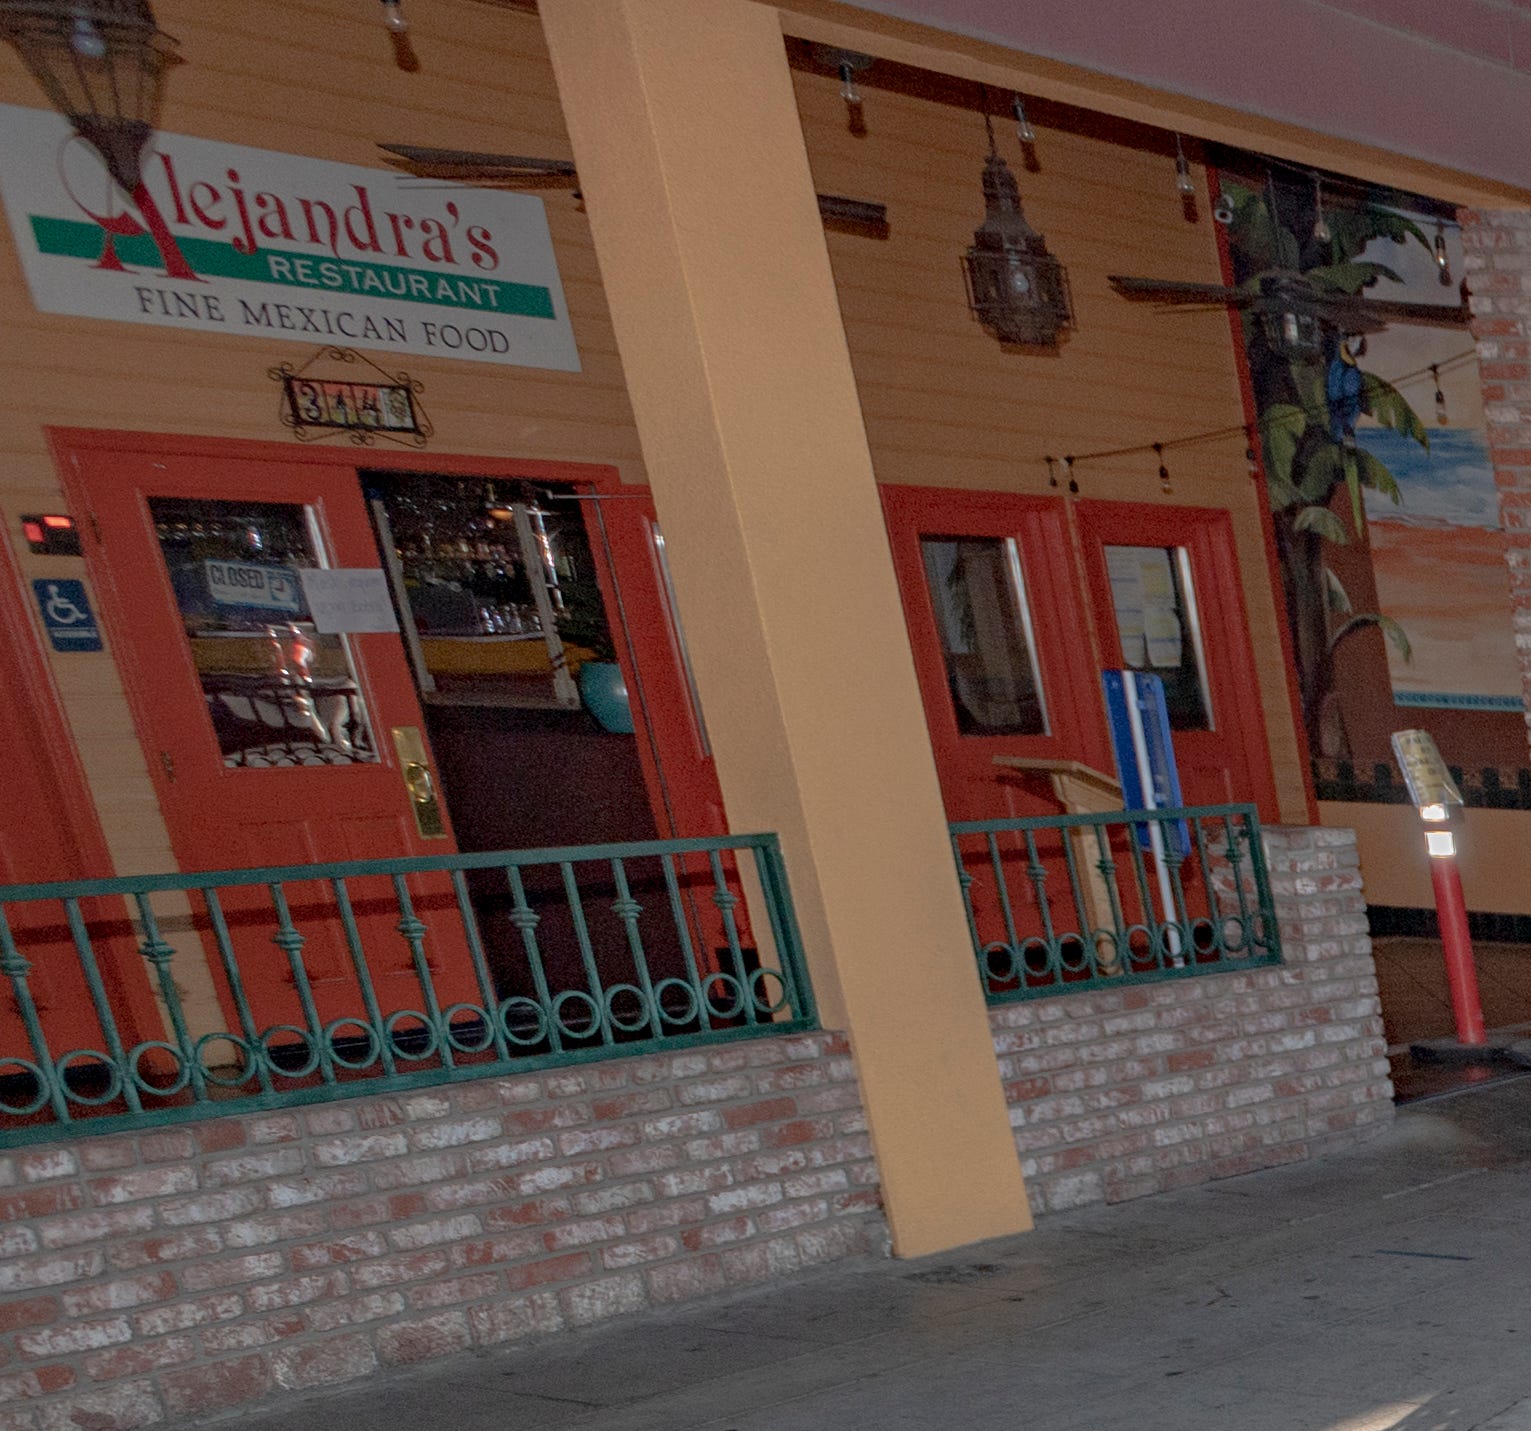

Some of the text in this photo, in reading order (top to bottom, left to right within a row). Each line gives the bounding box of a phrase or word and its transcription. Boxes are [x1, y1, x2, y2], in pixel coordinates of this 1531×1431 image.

[56, 136, 500, 284] Alejandra's
[266, 254, 501, 307] RESTAURANT
[134, 286, 510, 354] FINE MEXICAN FOOD
[209, 564, 265, 589] CLOSED
